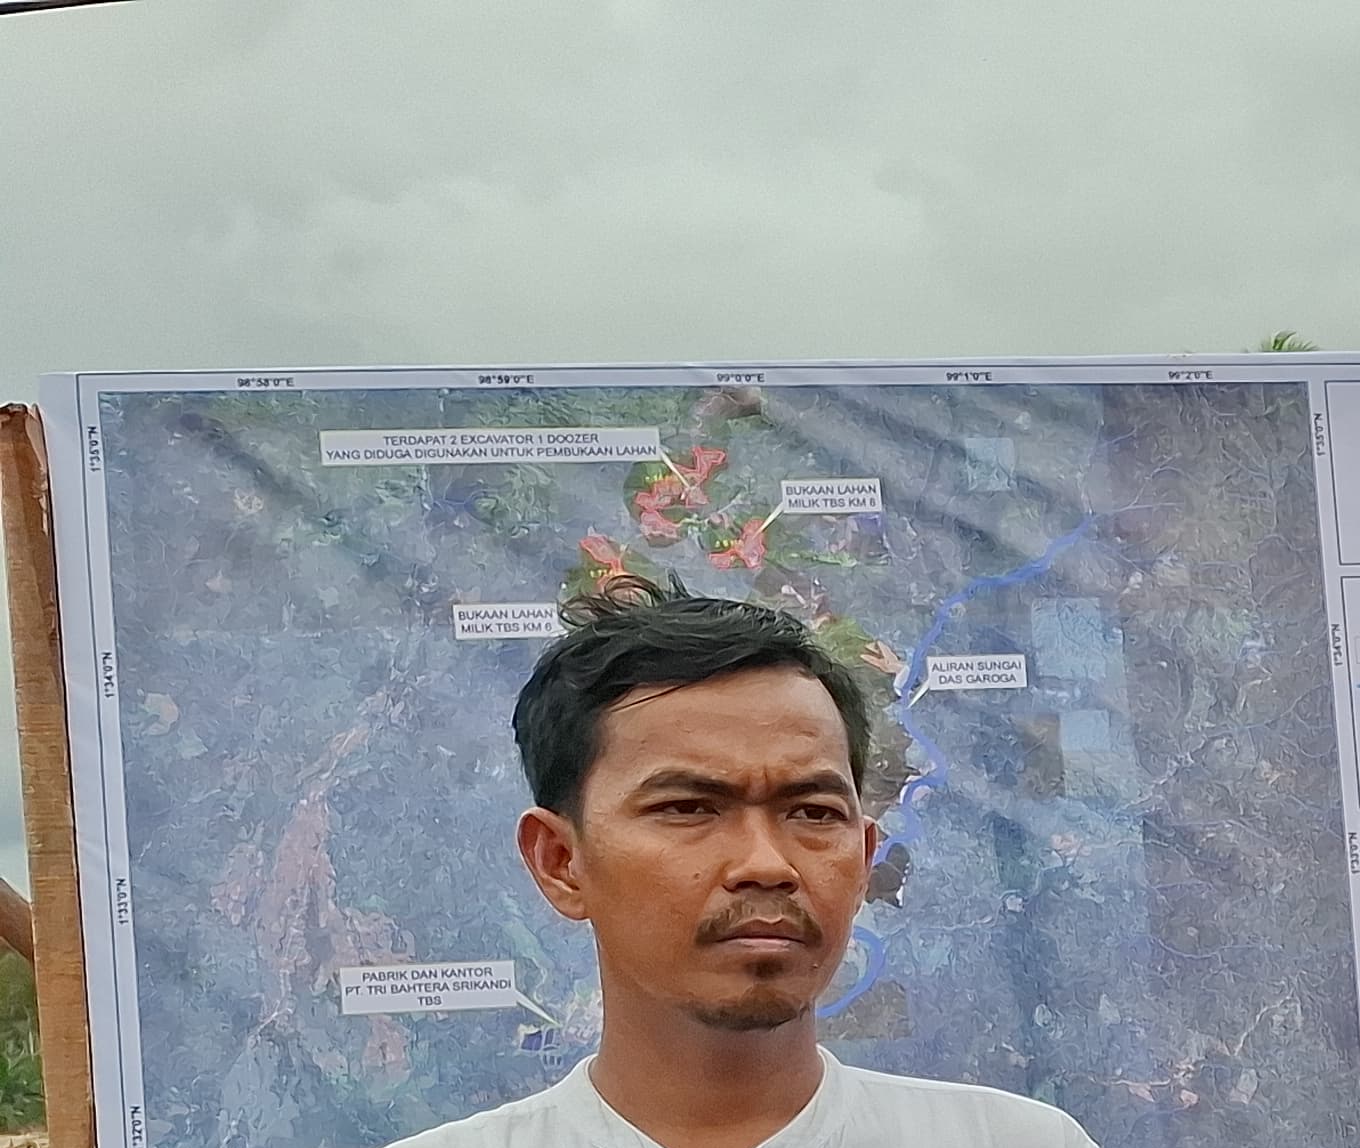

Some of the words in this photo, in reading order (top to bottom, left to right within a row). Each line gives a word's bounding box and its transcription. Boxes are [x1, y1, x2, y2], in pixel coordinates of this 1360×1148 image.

[383, 435, 446, 447] TERDAPAT
[449, 435, 458, 445] 2
[460, 433, 533, 445] EXCAVATOR
[546, 432, 599, 444] DOOZER
[326, 450, 361, 461] YANG
[364, 449, 412, 460] DIDUGA
[414, 447, 487, 459] DIGUNAKAN
[491, 446, 533, 458] UNTUK
[536, 445, 613, 457] PEMBUKAAN
[616, 444, 657, 457] LAHAN
[785, 485, 834, 496] BUKAAN
[837, 484, 877, 495] LAHAN
[788, 498, 821, 509] MILIK
[821, 498, 846, 507] TBS
[848, 497, 866, 507] KM
[458, 610, 508, 621] BUKAAN
[512, 609, 554, 620] LAHAN
[461, 623, 494, 633] MILIK
[496, 623, 520, 632] TBS
[523, 623, 542, 632] KM
[931, 662, 974, 673] ALIRAN
[976, 661, 1022, 671] SUNGAI
[939, 674, 963, 685] DAS
[965, 673, 1017, 684] GAROGA
[362, 970, 408, 982] PABRIK
[411, 969, 438, 980] DAN
[440, 967, 493, 978] KANTOR
[345, 985, 364, 996] PT.
[367, 985, 387, 995] TRI
[390, 981, 450, 994] BAHTERA
[452, 979, 512, 992] SRIKANDI
[417, 995, 442, 1007] TBS
